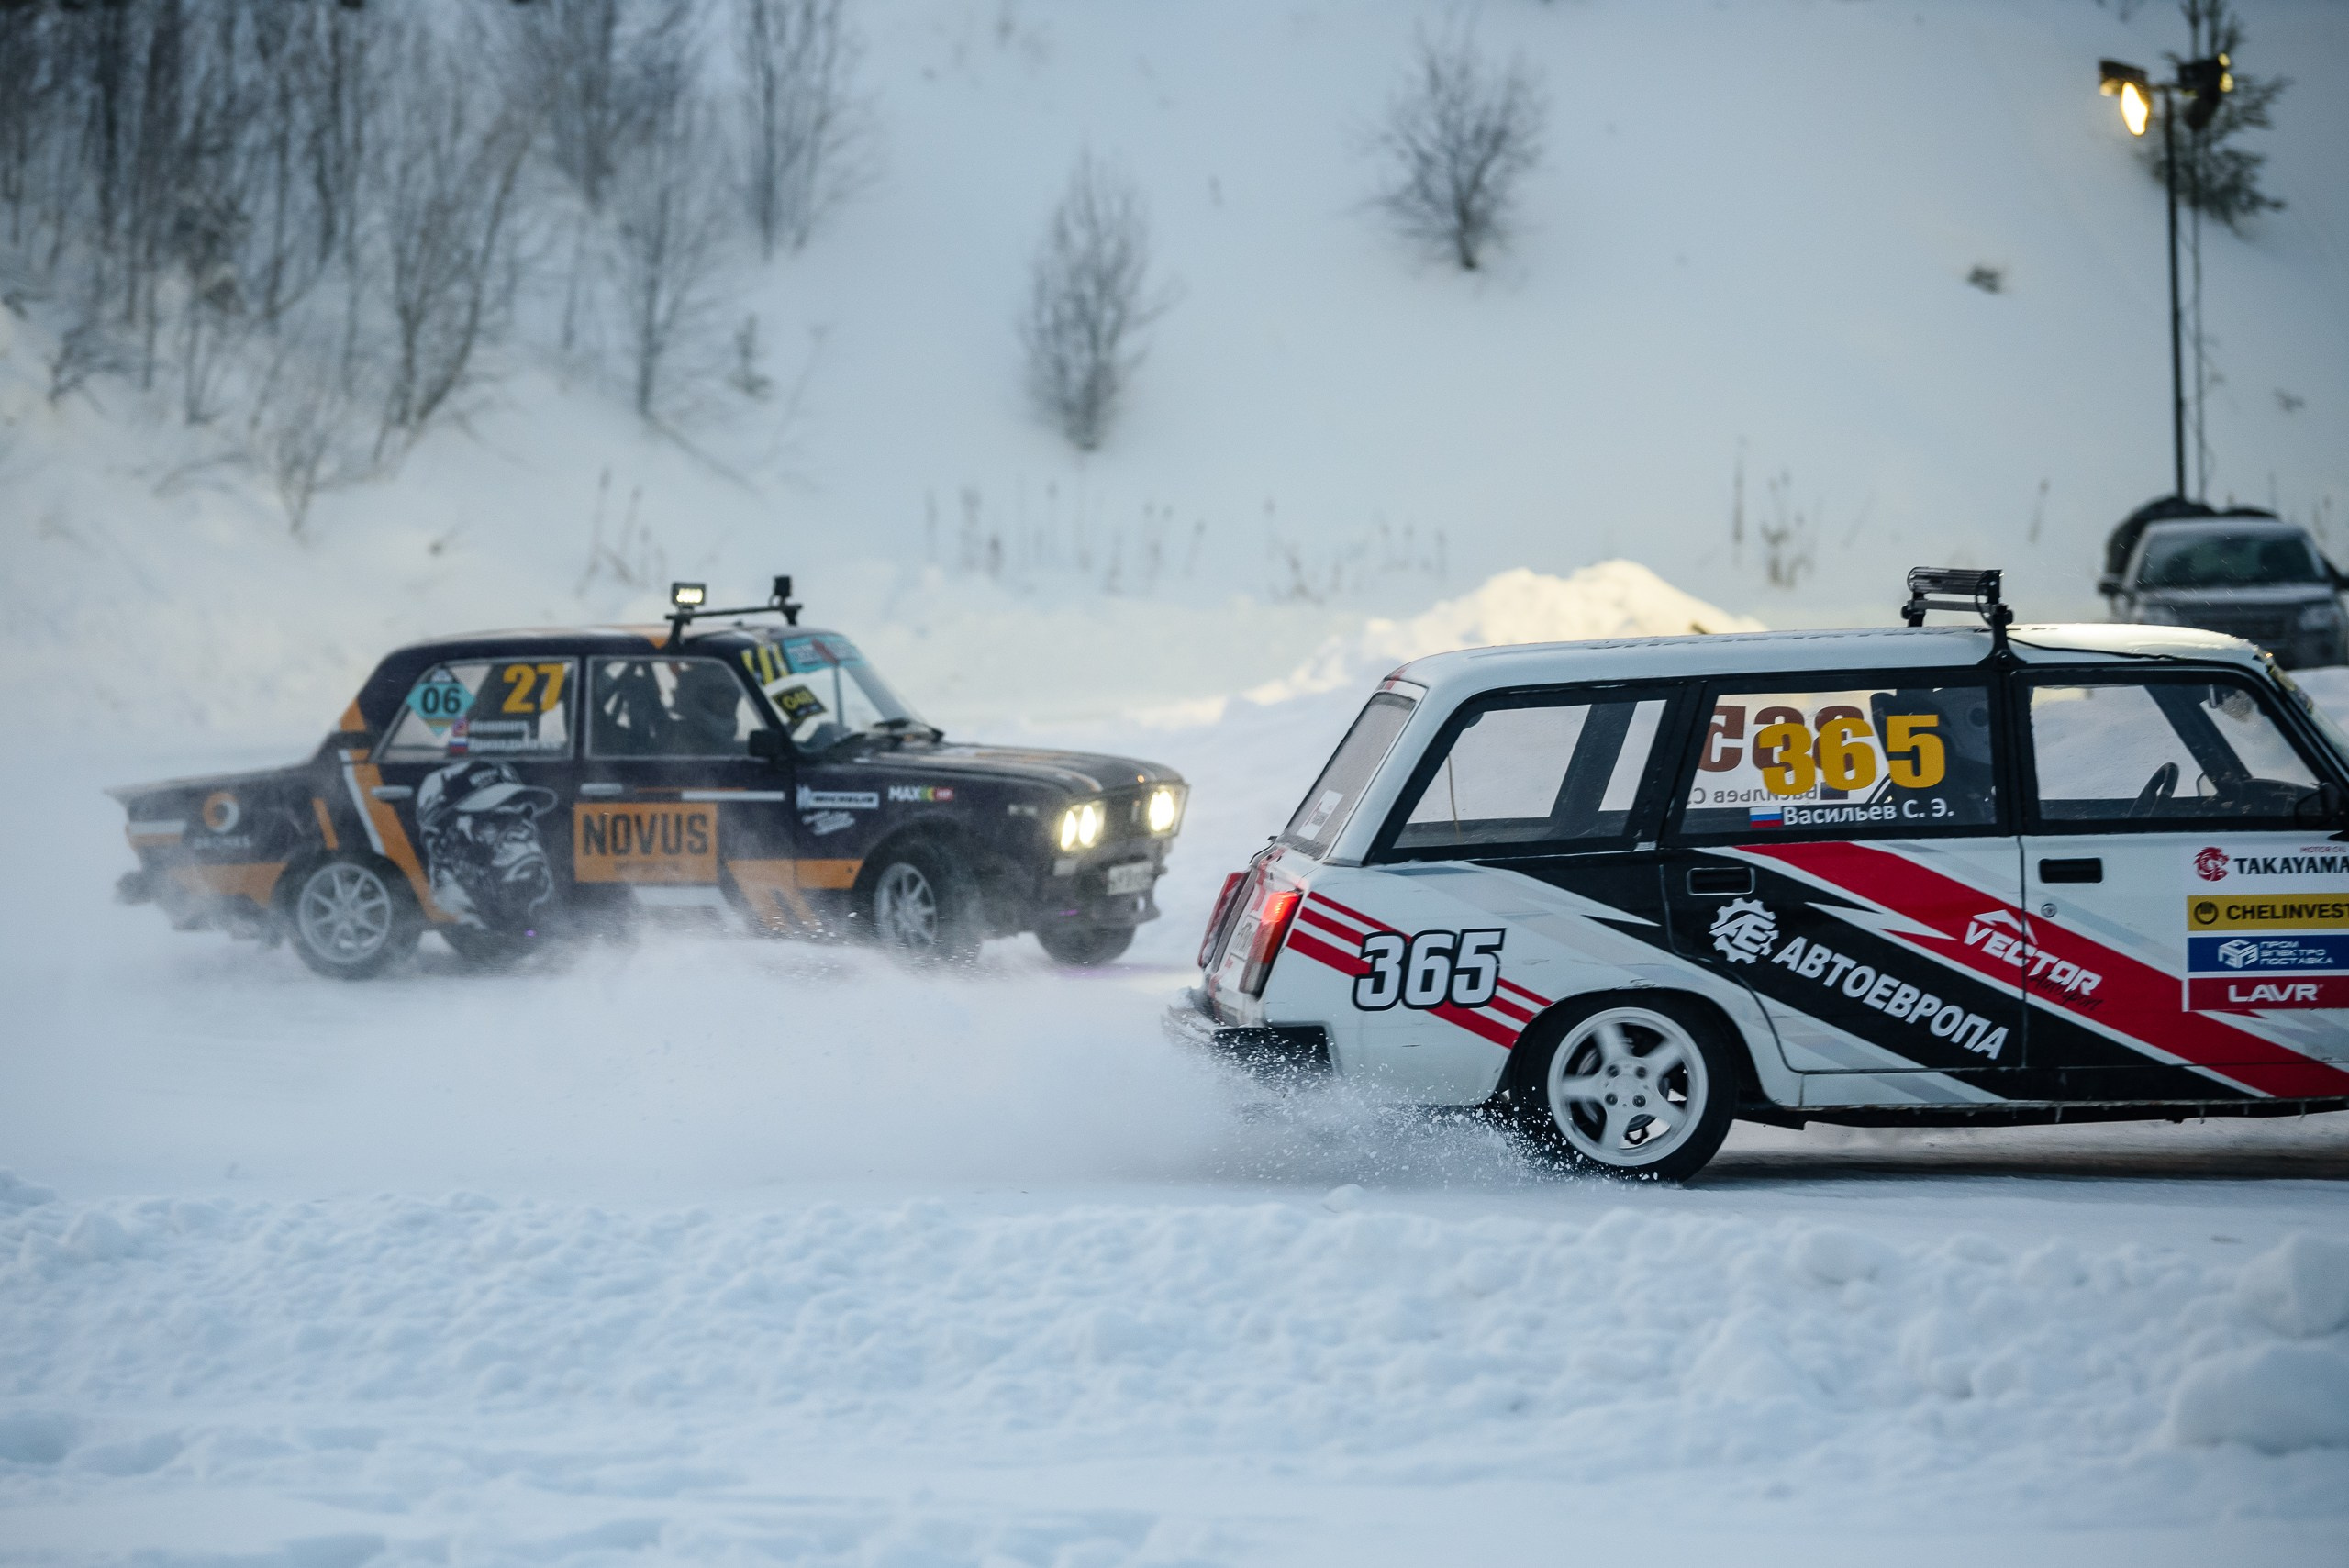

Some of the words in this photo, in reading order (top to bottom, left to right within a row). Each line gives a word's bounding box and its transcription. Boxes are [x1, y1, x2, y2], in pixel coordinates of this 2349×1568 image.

[421, 687, 462, 714] 06
[502, 662, 565, 713] 27
[1758, 714, 1946, 795] 365
[1783, 804, 1898, 826] Васильев
[1902, 799, 1925, 819] С.
[1931, 797, 1955, 817] Э.
[583, 813, 708, 856] NOVUS
[2233, 856, 2349, 874] TAKAYAMA
[1964, 921, 2103, 996] VECTOR
[2260, 940, 2299, 949] ПРОМ
[2260, 949, 2326, 957] ЭЛЕКТРО
[1352, 928, 1507, 1012] 365
[2260, 957, 2333, 965] ПОСТАВКА
[1771, 936, 2009, 1060] АВТОЕВРОПА
[2228, 984, 2319, 1003] LAVR
